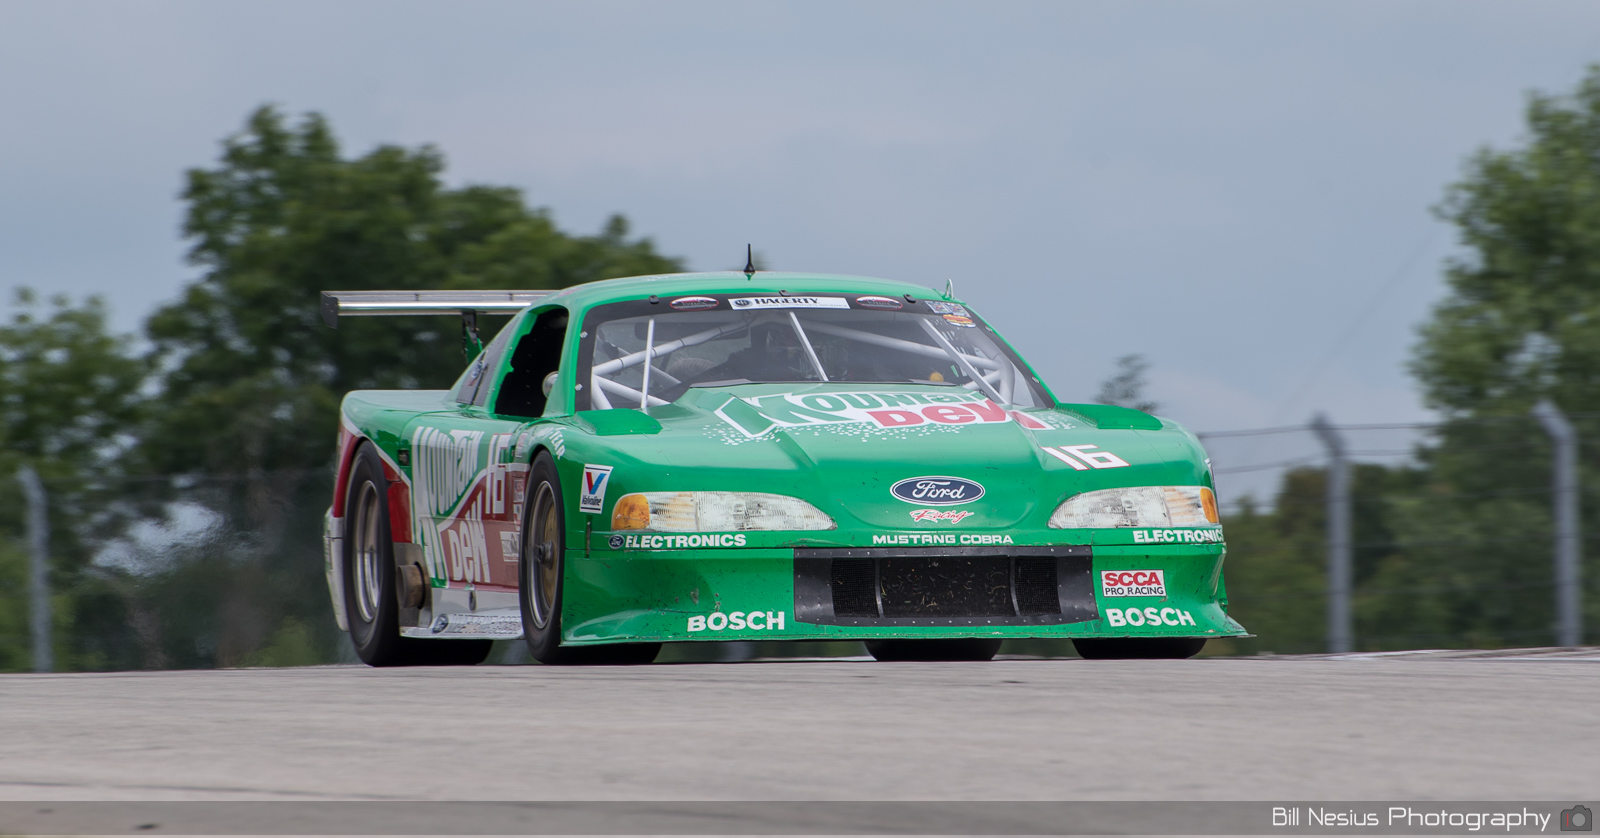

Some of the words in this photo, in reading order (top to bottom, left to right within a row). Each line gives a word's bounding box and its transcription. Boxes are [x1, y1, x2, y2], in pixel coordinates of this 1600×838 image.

[1041, 444, 1131, 471] 16
[486, 433, 513, 514] 16
[912, 480, 965, 499] Ford
[582, 495, 602, 506] Valvoline
[909, 509, 974, 523] Racing
[625, 534, 747, 548] ELECTRONICS
[872, 534, 956, 544] MUSTANG
[960, 534, 1014, 544] COBRA
[1104, 572, 1162, 587] SCCA
[1105, 587, 1124, 595] PRO
[1127, 586, 1164, 595] RACING
[687, 611, 785, 632] BOSCH
[1105, 607, 1197, 627] BOSCH
